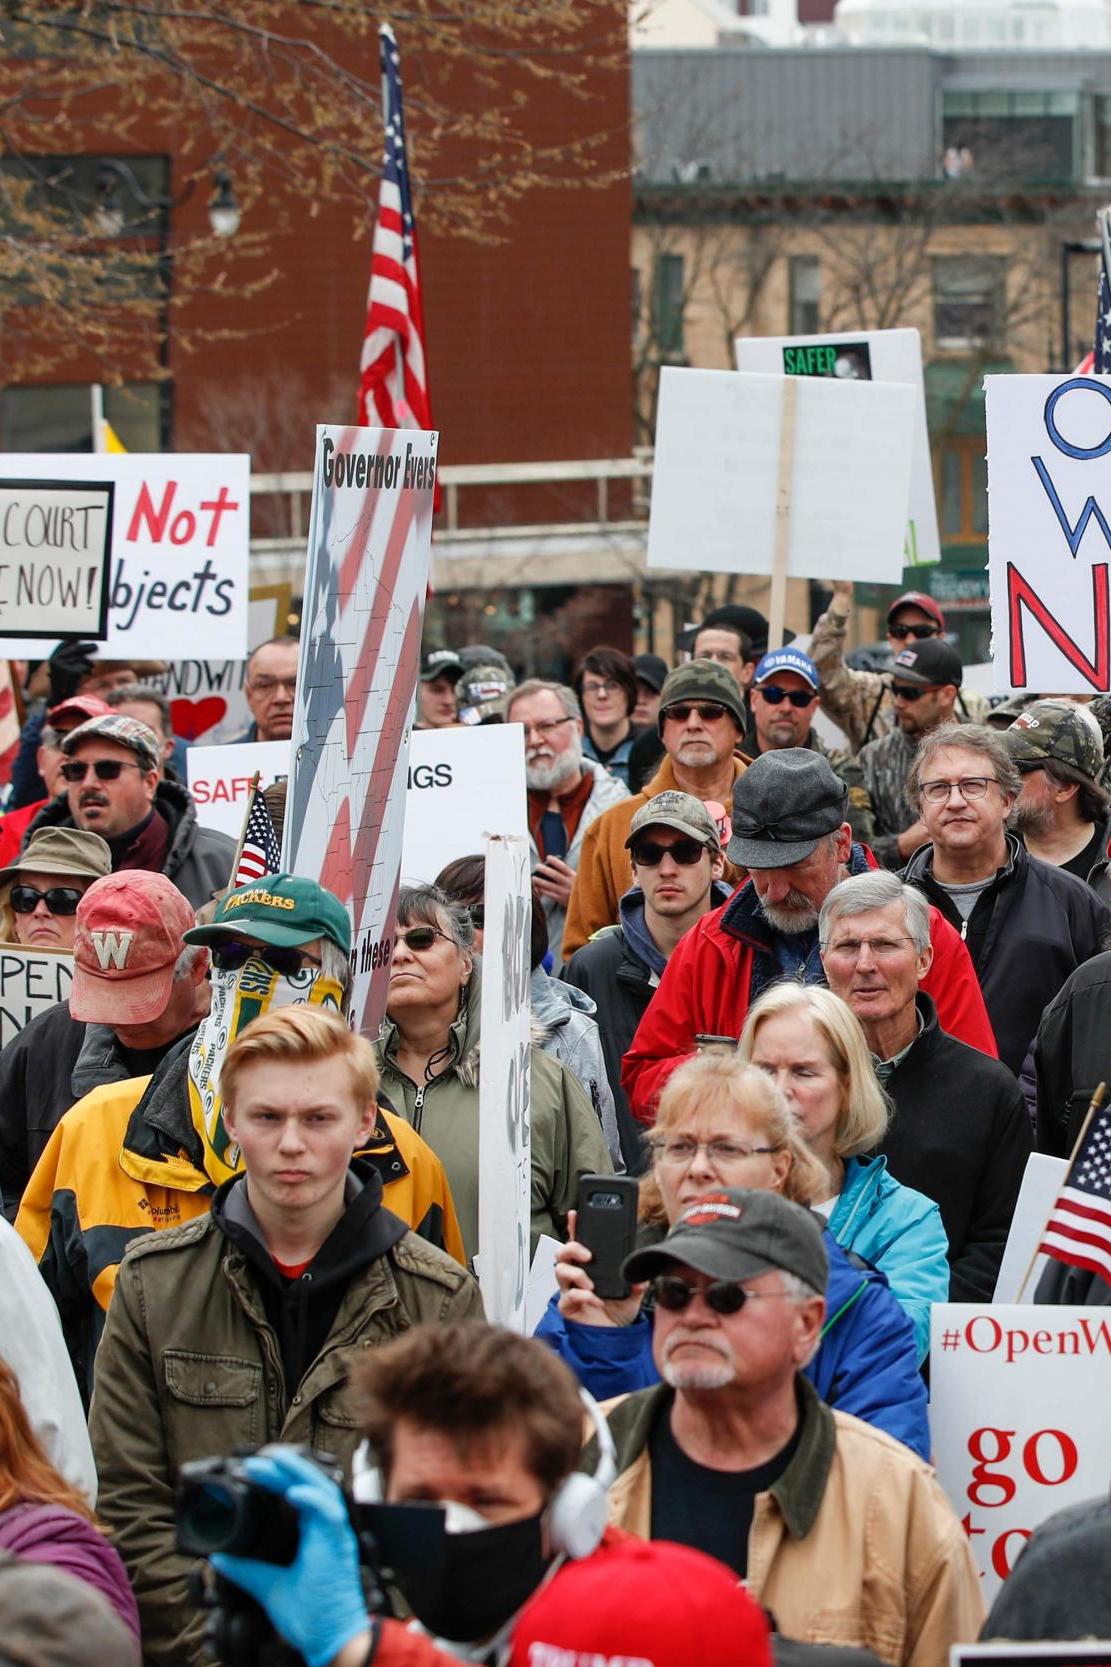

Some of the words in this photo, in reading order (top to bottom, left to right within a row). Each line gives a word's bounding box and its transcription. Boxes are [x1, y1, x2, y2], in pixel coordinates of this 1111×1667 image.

[784, 346, 837, 376] SAFER
[323, 437, 401, 489] Governor
[403, 442, 436, 490] Evers
[3, 502, 105, 551] COURT
[126, 480, 240, 547] Not
[16, 562, 98, 610] NOW!
[108, 557, 235, 631] bjects
[774, 654, 813, 675] YAMAHA
[222, 891, 296, 915] PACKERS
[90, 931, 134, 970] W
[360, 929, 391, 975] these
[199, 1042, 217, 1091] PACKERS
[966, 1426, 1079, 1508] go
